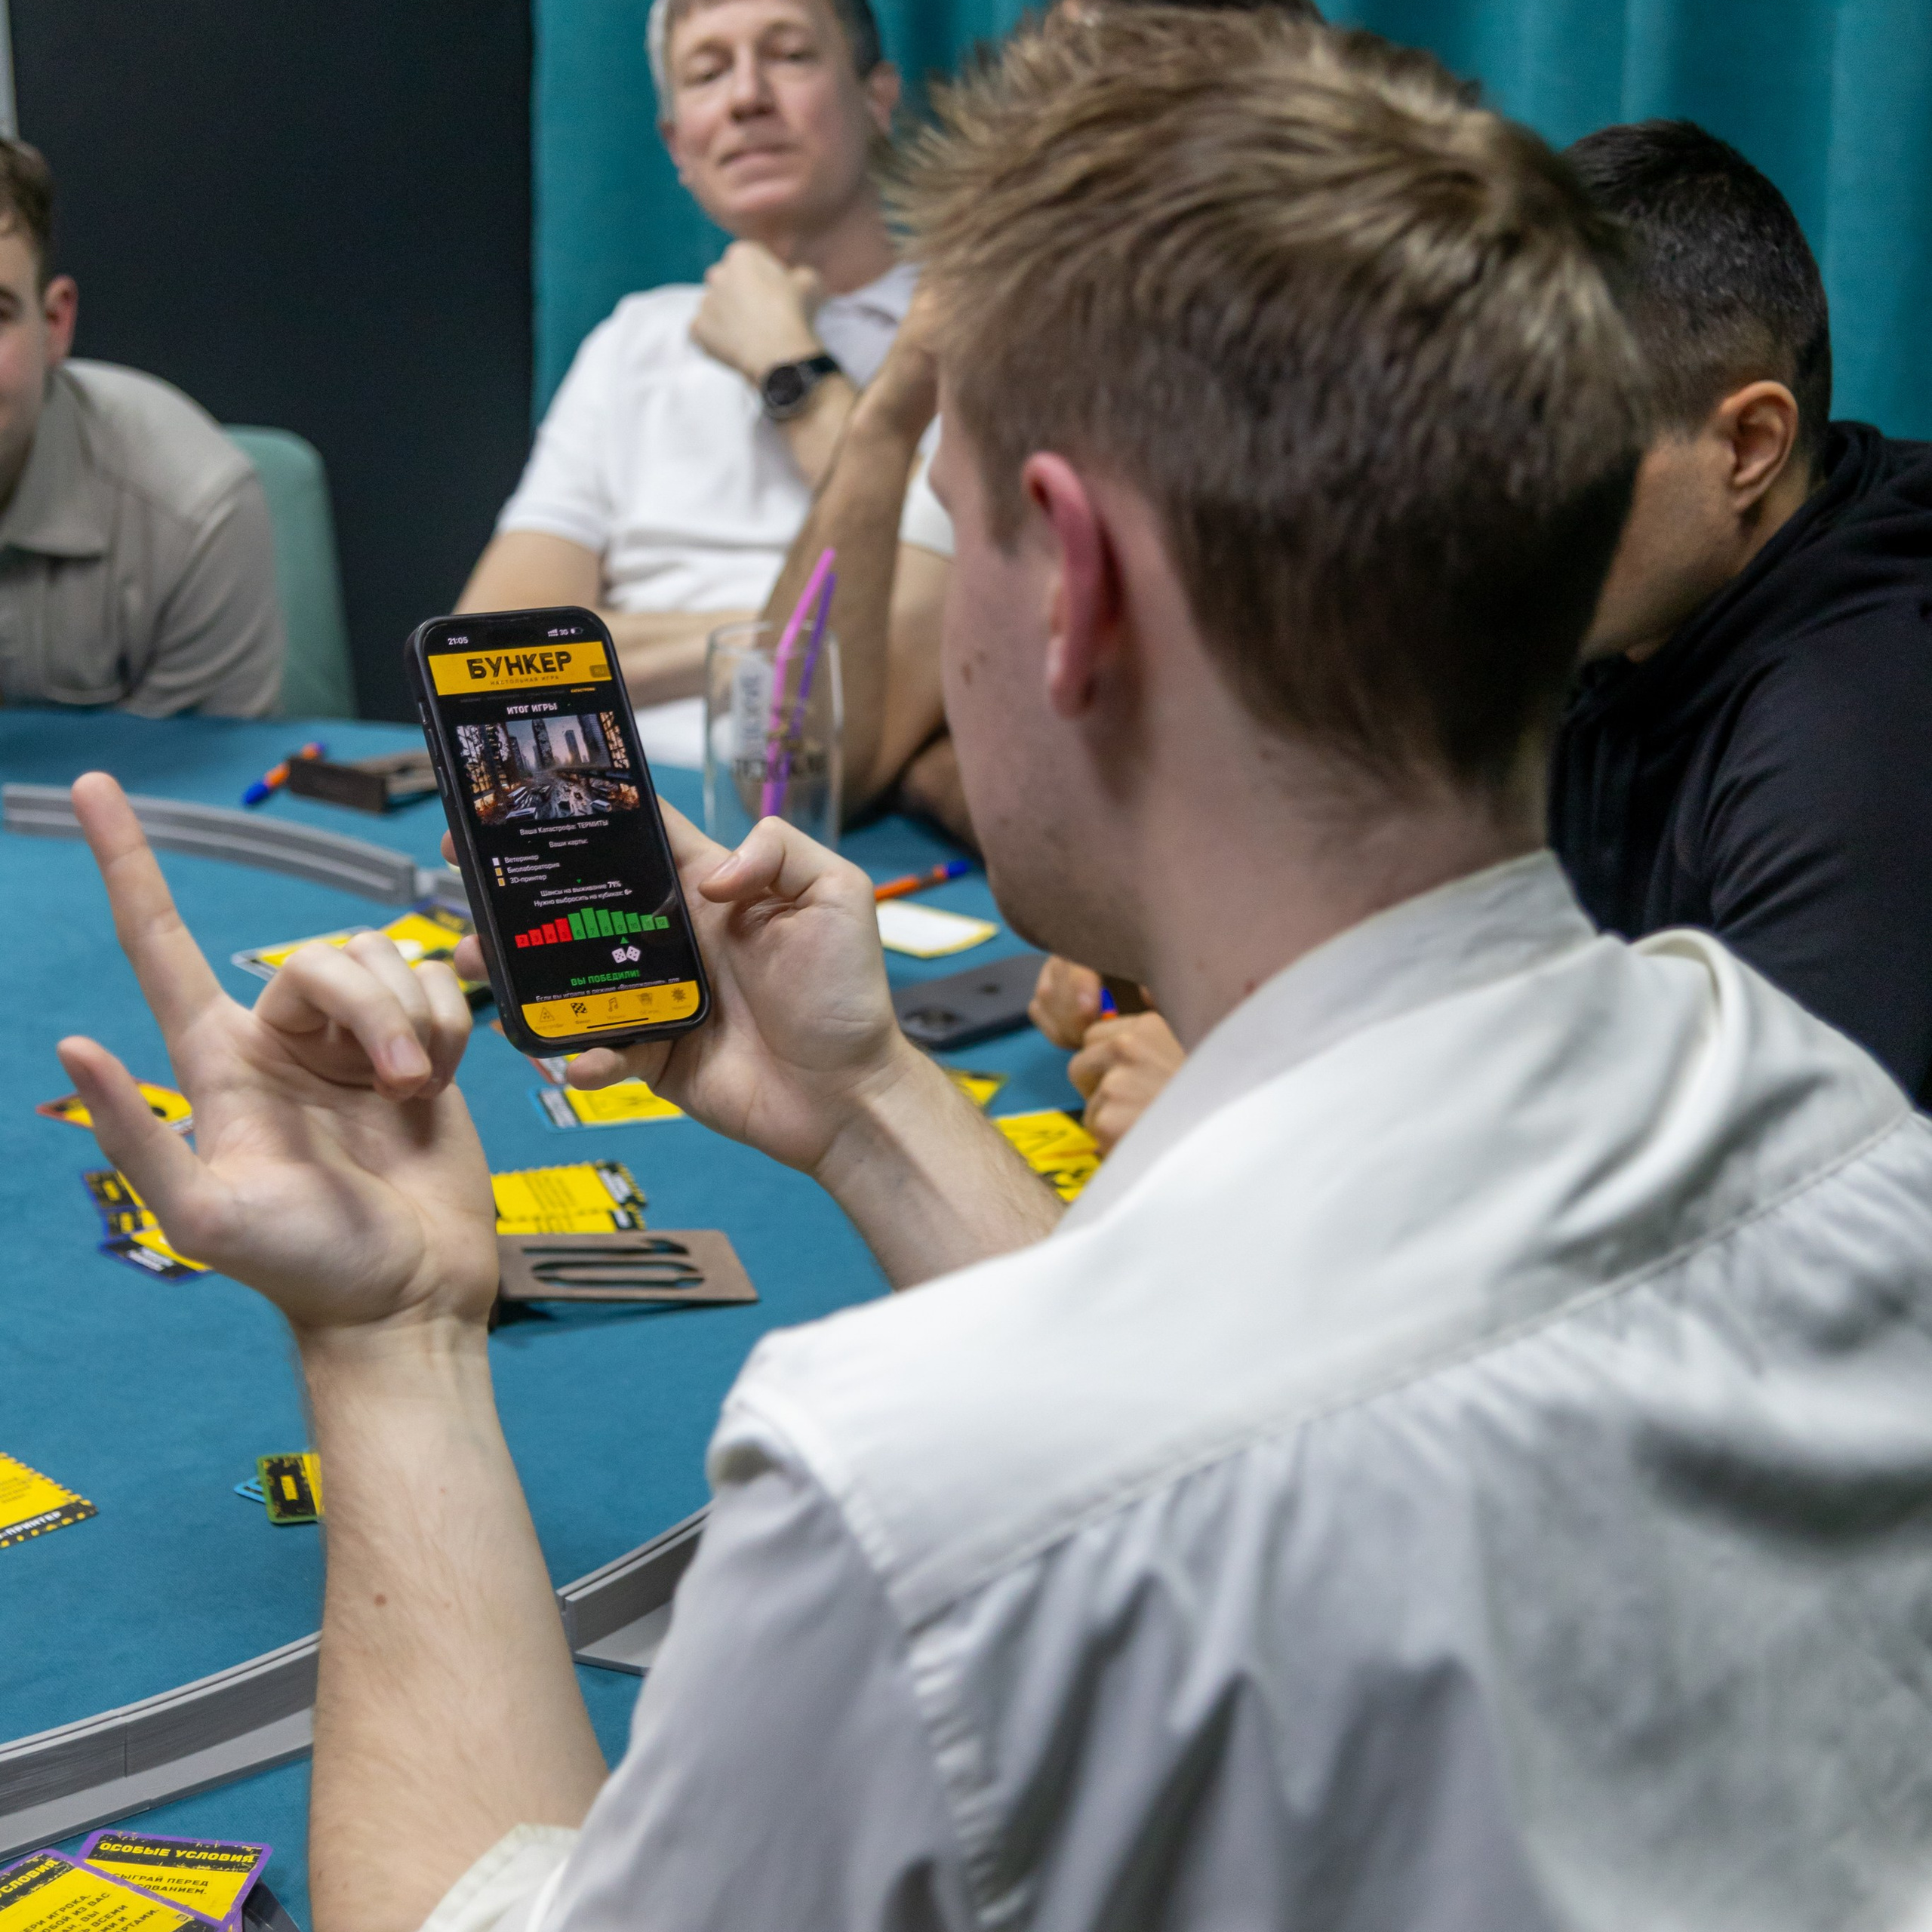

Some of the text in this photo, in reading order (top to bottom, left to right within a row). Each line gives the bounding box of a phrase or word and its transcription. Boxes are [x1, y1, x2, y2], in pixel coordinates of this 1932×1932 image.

[448, 636, 469, 645] 21:05
[466, 651, 571, 679] БУНКЕР
[491, 676, 538, 686] НАСТОЛЬНАЯ
[506, 703, 558, 715] ИТОГ ИГРЫ
[537, 824, 577, 835] Катастрофа:
[577, 820, 609, 829] ТЕРМИТЫ
[504, 854, 540, 863] Ветеринар
[506, 862, 561, 874] Биолаборатория
[509, 874, 547, 884] 3D-принтер
[572, 884, 608, 893] выживание
[534, 899, 555, 907] Нужно
[555, 895, 589, 904] выбросить
[571, 970, 641, 986] ВЫ ПОБЕДИЛИ!
[99, 1842, 255, 1863] ОСОБЫЕ УСЛОВИЯ
[0, 1859, 60, 1898] СЛОВИЯ
[167, 1877, 209, 1887] ПЕРЕД
[46, 1895, 91, 1920] ИГРОКА.
[72, 1906, 88, 1916] ИЗ
[88, 1893, 110, 1906] ВАС
[80, 1911, 100, 1922] ВЫ
[91, 1905, 128, 1927] ВСЕМИ
[116, 1909, 160, 1932] РТАМИ.
